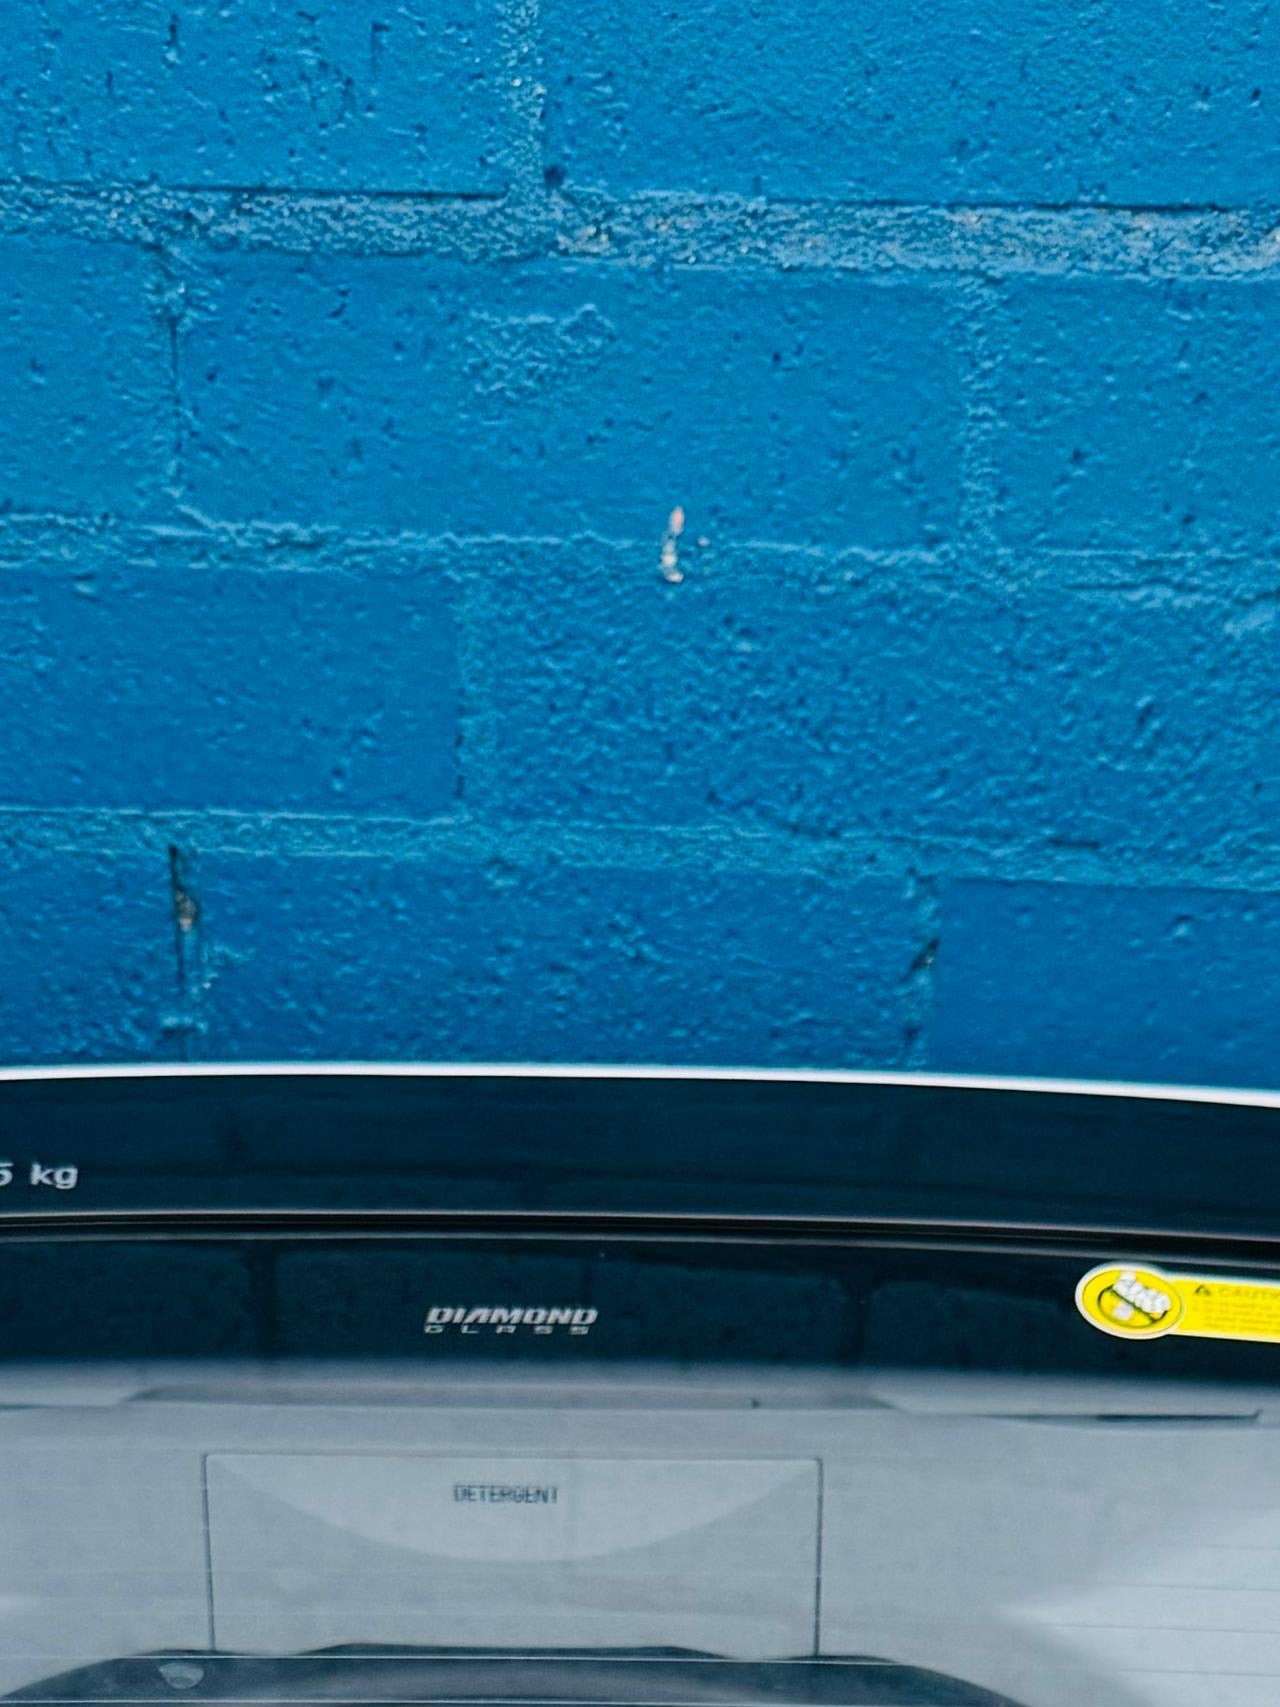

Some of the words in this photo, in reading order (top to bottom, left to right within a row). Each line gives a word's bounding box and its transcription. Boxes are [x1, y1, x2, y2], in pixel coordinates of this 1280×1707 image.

[30, 1164, 78, 1191] kg
[427, 1306, 599, 1325] DIAMOND
[424, 1324, 590, 1335] GLASS
[453, 1484, 558, 1504] DETERGENT
